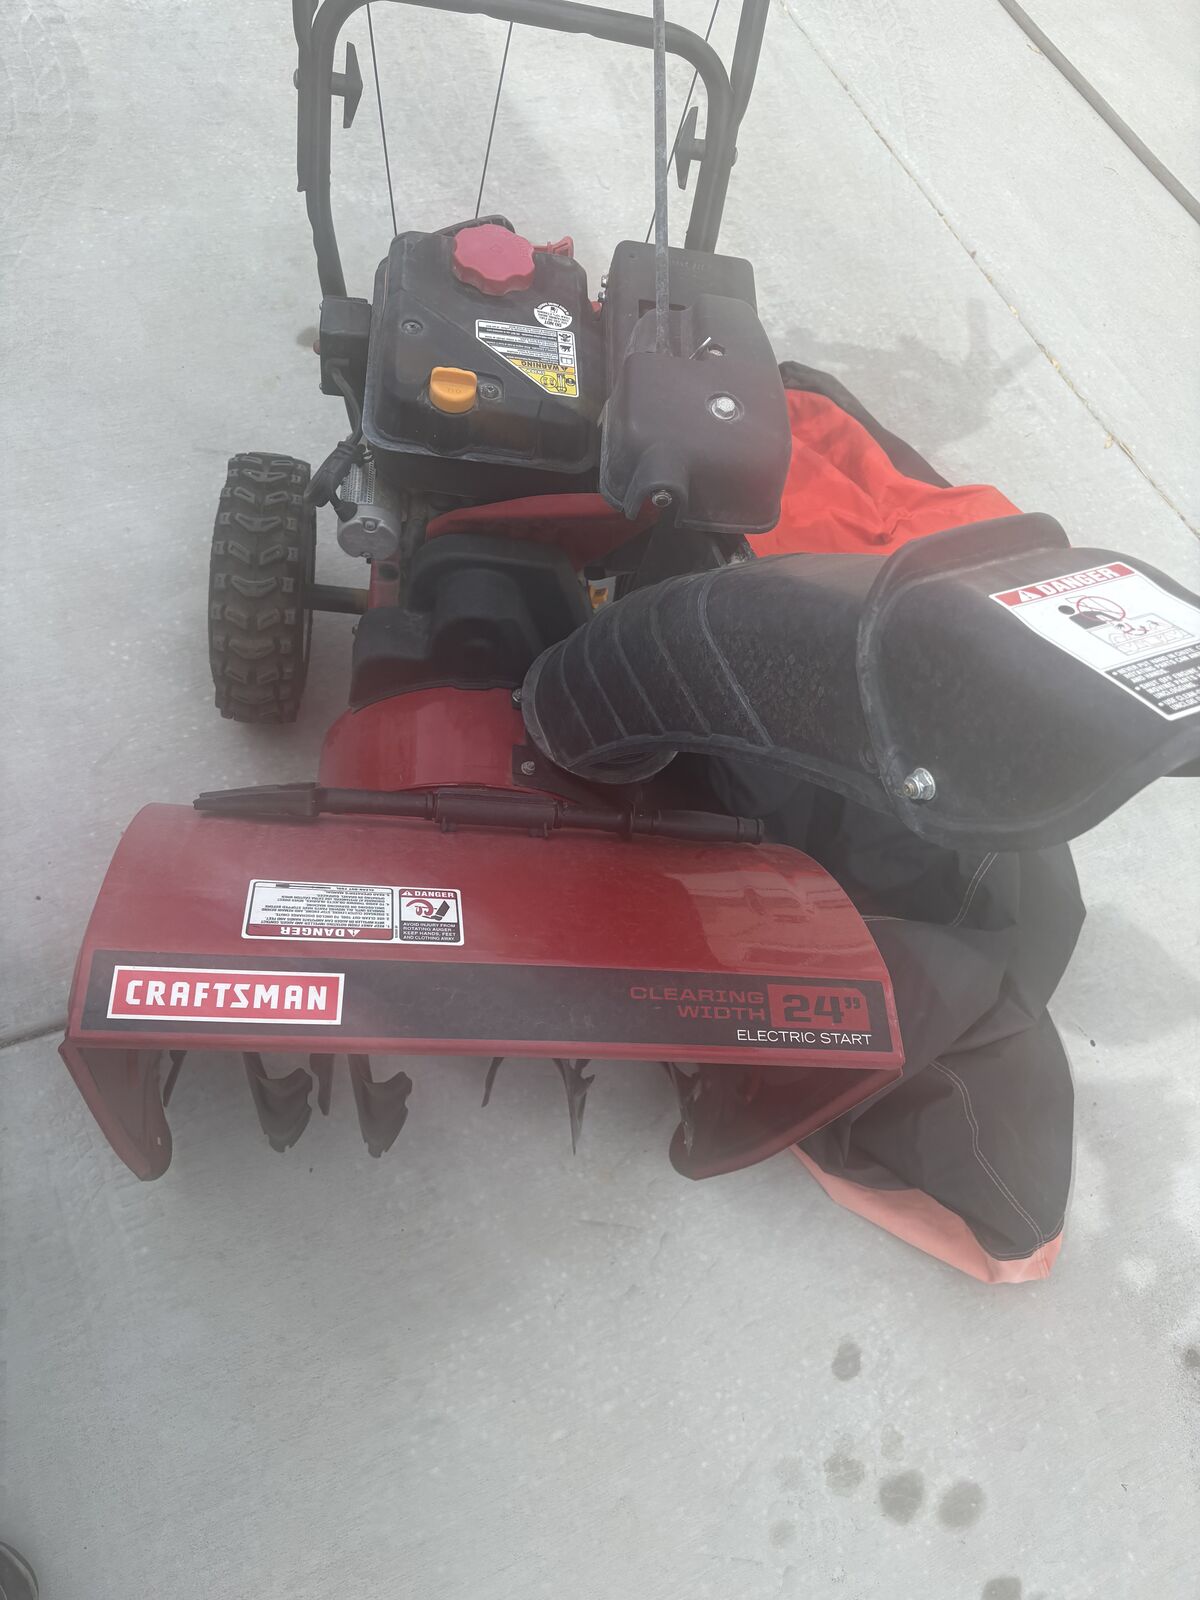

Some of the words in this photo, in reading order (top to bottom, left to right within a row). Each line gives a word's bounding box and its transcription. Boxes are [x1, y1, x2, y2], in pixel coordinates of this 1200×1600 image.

[521, 360, 559, 371] WARNING
[1039, 567, 1119, 595] DANGER
[280, 926, 345, 937] DANGER
[125, 980, 327, 1011] CRAFTSMAN
[630, 986, 765, 1005] CLEARING
[677, 1005, 766, 1021] WIDTH
[736, 1029, 816, 1044] ELECTRIC
[820, 1032, 872, 1045] START
